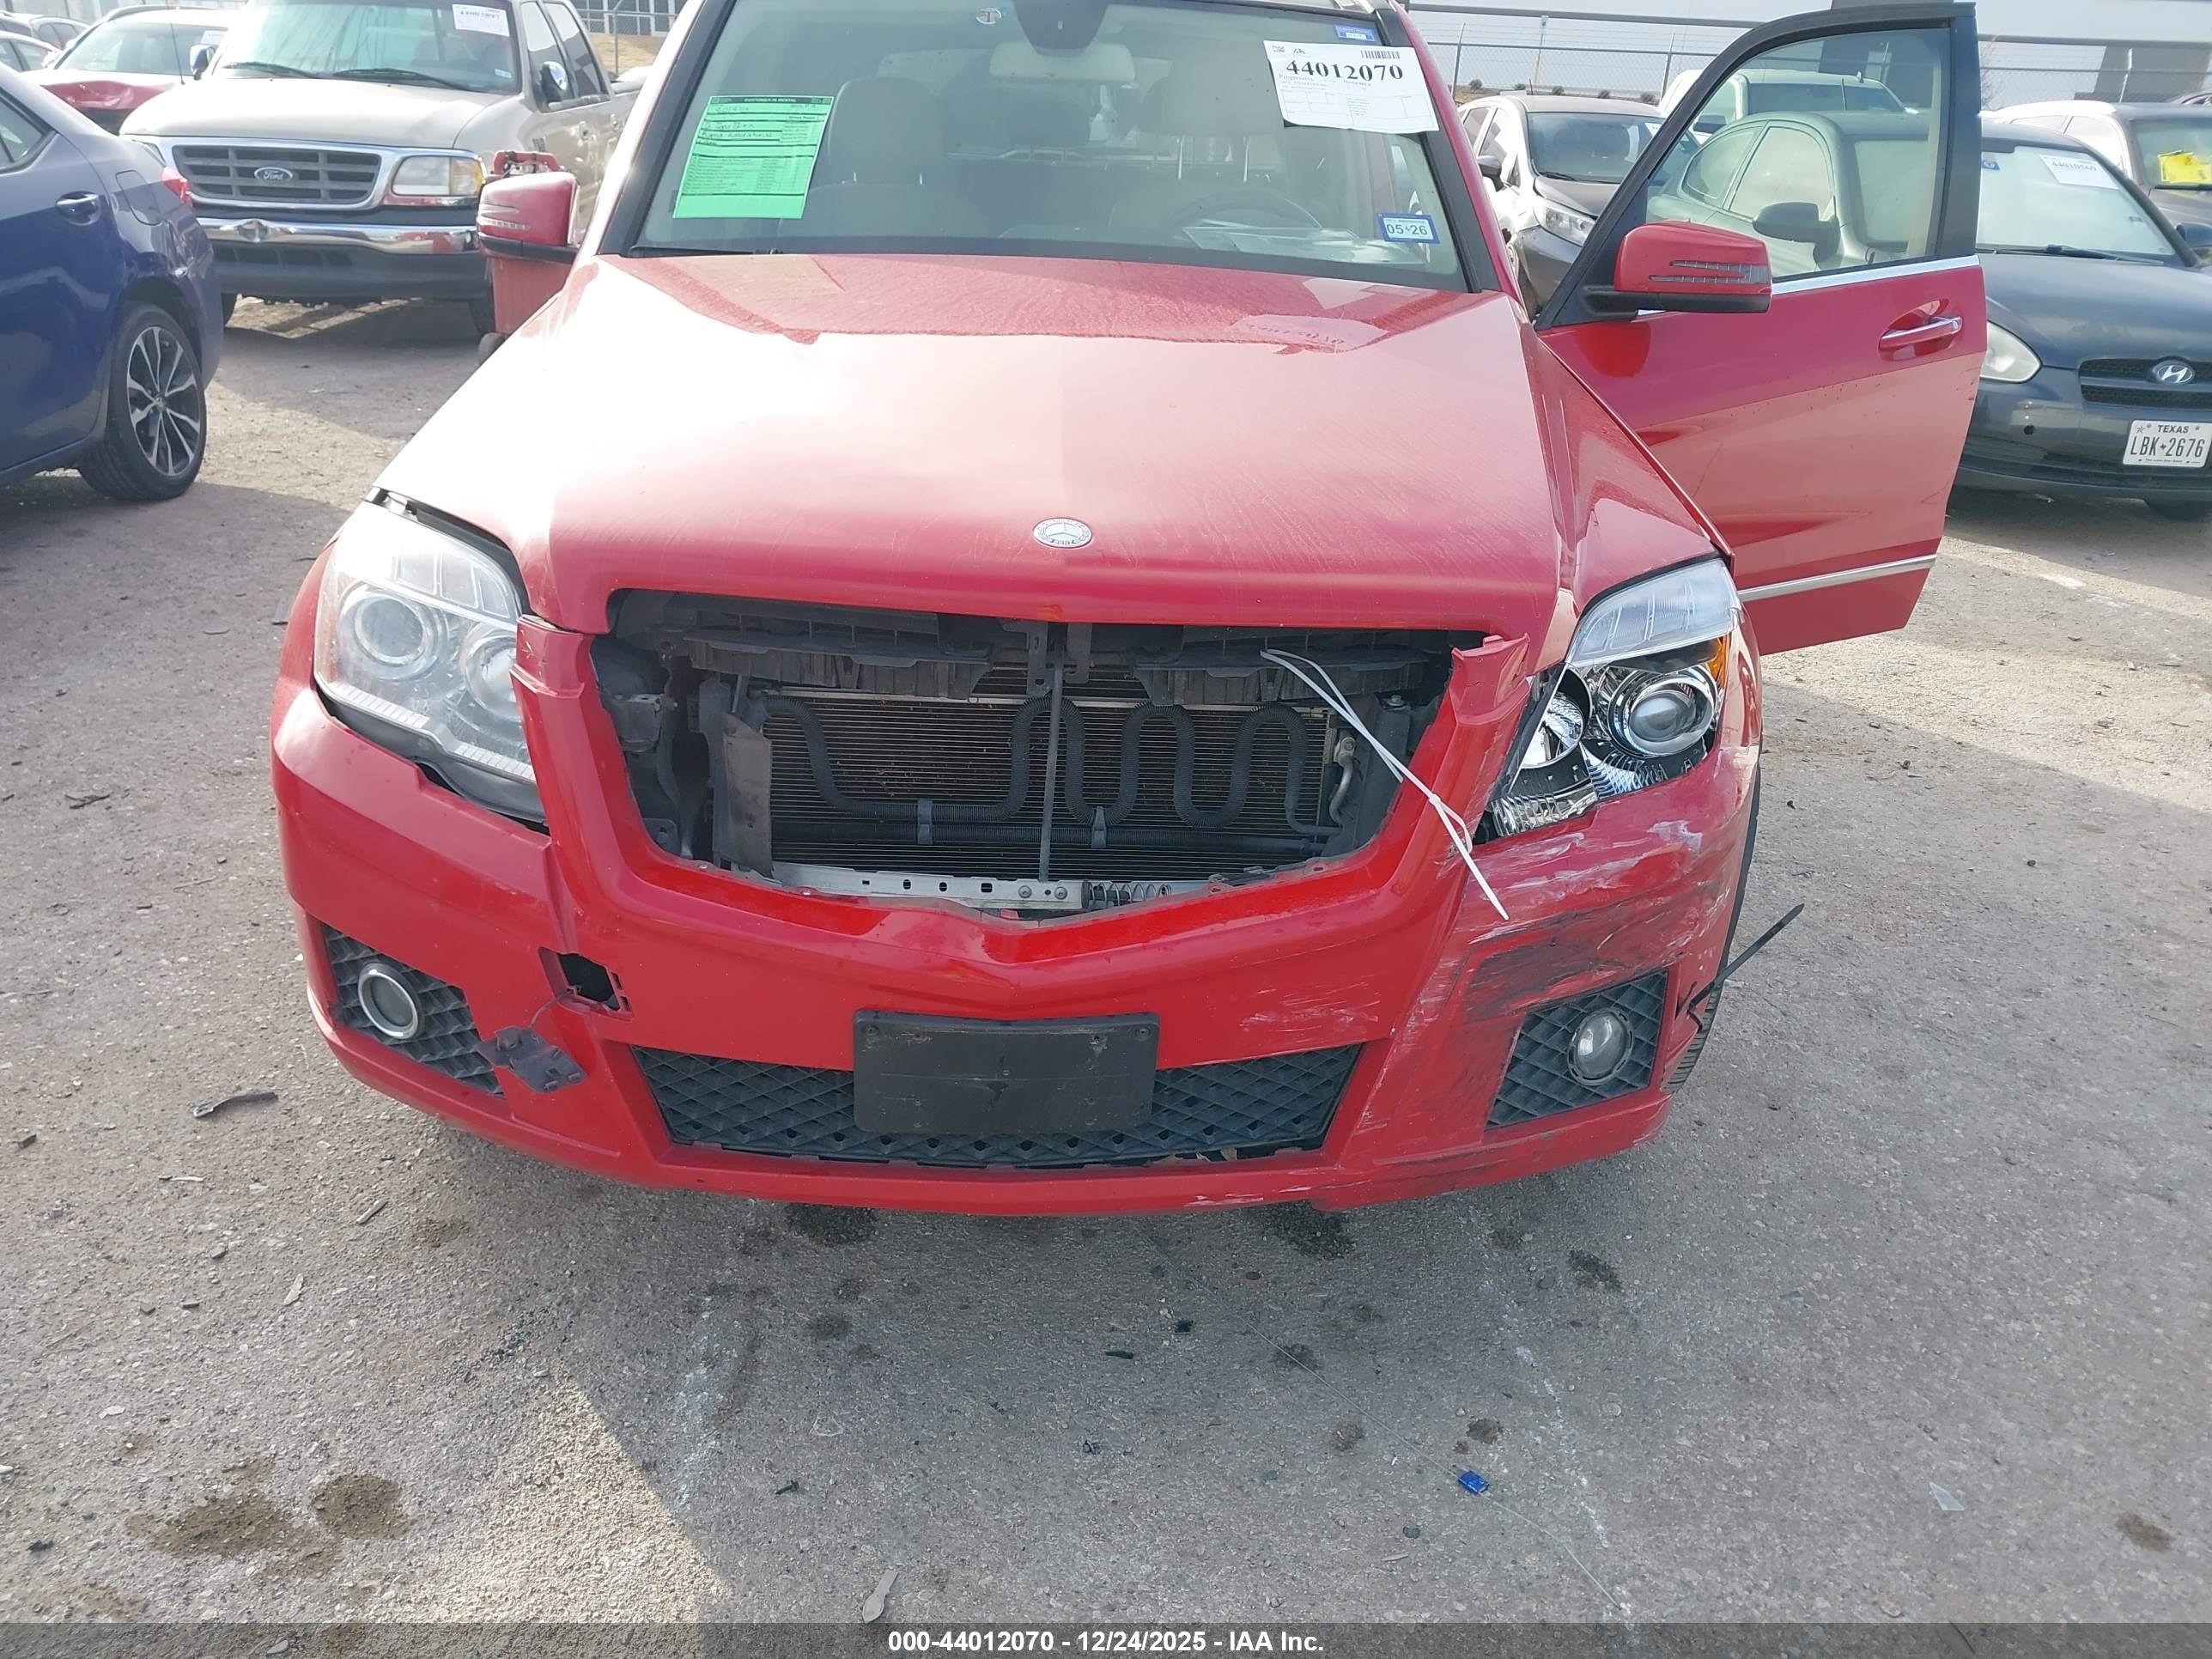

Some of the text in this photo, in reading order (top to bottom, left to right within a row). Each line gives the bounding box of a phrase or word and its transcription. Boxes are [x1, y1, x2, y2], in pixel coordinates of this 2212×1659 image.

[1285, 59, 1404, 82] 44012070
[1386, 223, 1428, 235] 05 26
[2157, 424, 2190, 434] TEXAS
